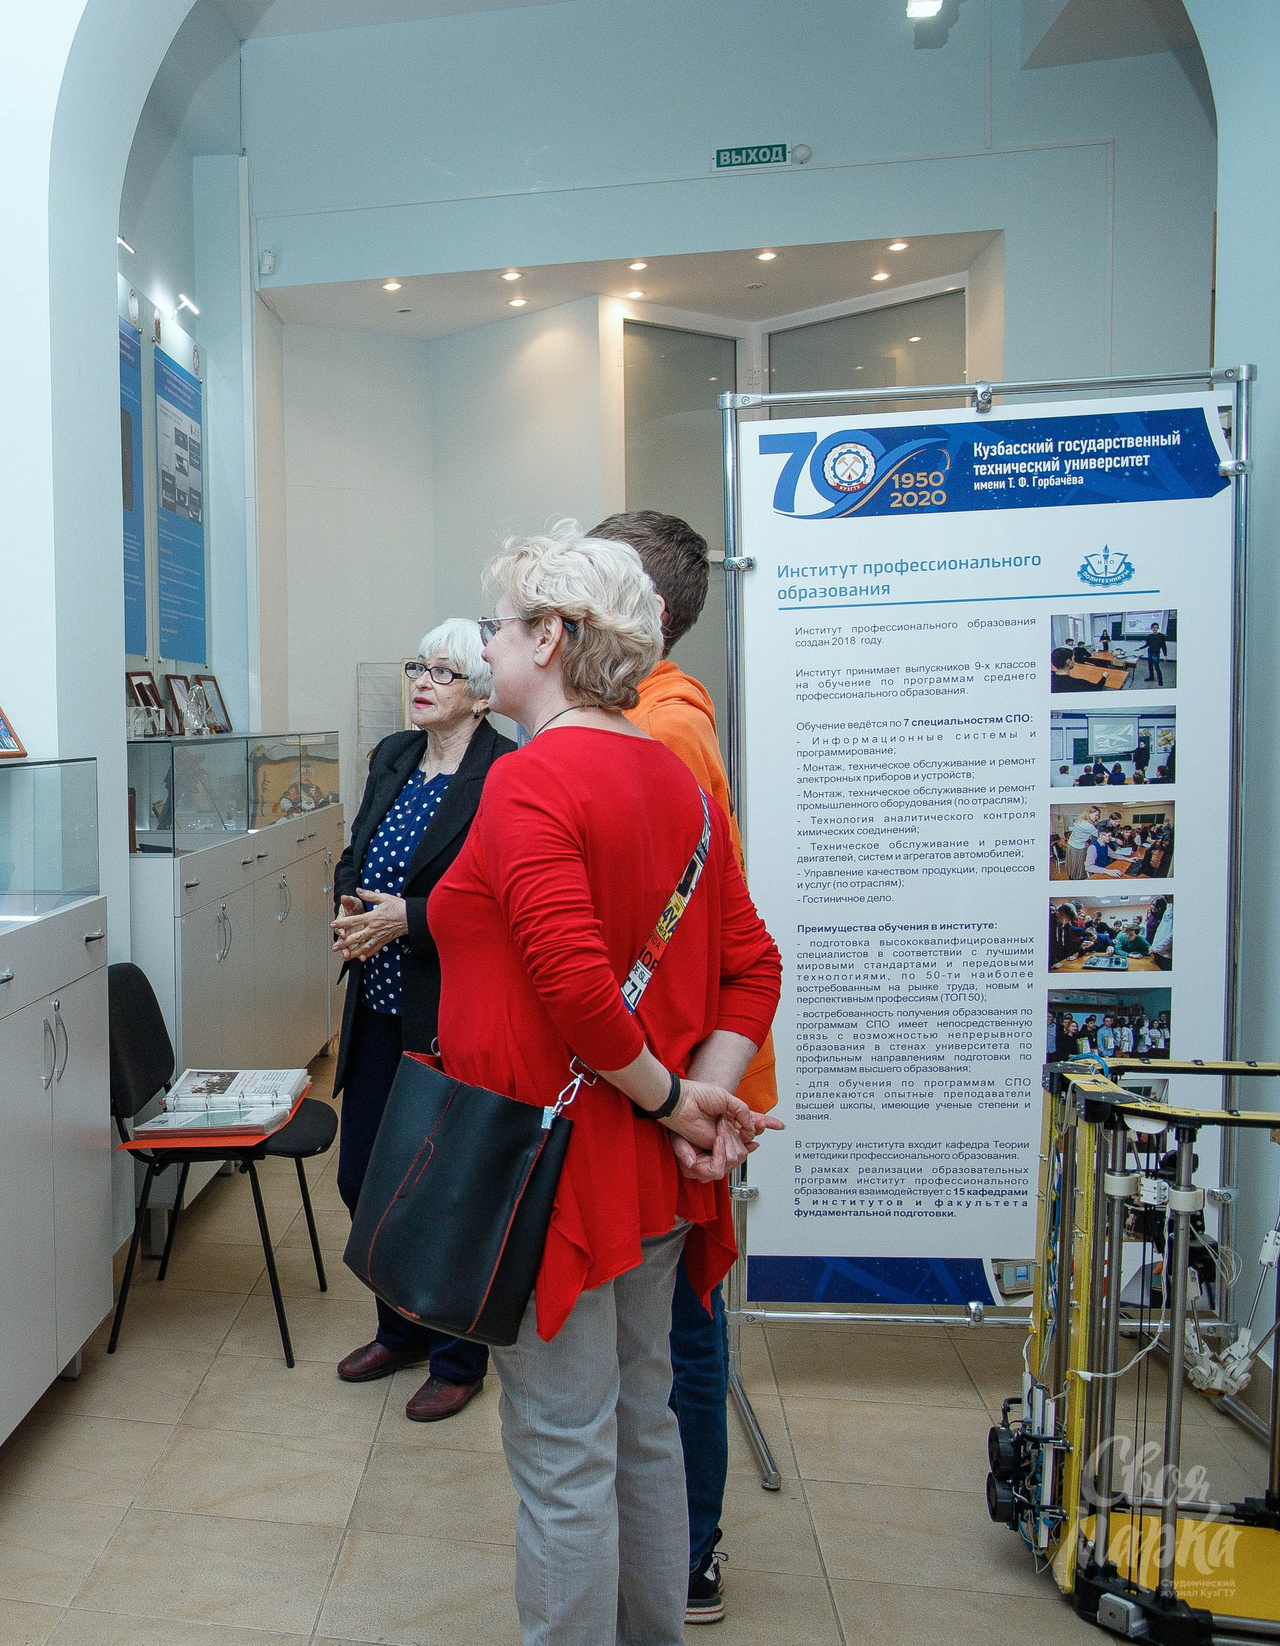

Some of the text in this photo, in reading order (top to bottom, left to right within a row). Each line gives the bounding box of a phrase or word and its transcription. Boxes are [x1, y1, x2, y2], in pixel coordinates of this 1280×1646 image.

[720, 146, 784, 166] ВЫХОД
[973, 430, 1181, 460] Кузбасский государственный
[973, 454, 1150, 476] технический университет
[892, 471, 945, 489] 1950
[973, 474, 1084, 491] имени Т. Ф. Горбачёва
[890, 490, 947, 508] 2020
[777, 553, 1042, 580] Институт профессионального
[777, 581, 891, 602] образования
[794, 617, 1036, 637] Институт профессионального образования
[794, 636, 884, 648] создан 2018 году.
[794, 661, 1036, 678] Институт принимает выпускников 9-х классов
[817, 677, 872, 690] обучение
[902, 676, 974, 687] программам
[983, 674, 1036, 684] среднего
[795, 686, 968, 703] профессионального образования.
[795, 720, 846, 732] Обучение
[846, 718, 888, 730] ведётся
[902, 718, 910, 726] 7
[910, 716, 1004, 728] специальностям
[1004, 713, 1033, 723] СПО:
[796, 775, 862, 785] электронных
[862, 771, 912, 783] приборов
[920, 770, 974, 782] устройств;
[796, 795, 1027, 811] промышленного оборудования (по отраслям);
[796, 922, 876, 935] Преимущества
[877, 922, 930, 933] обучения
[938, 922, 998, 932] институте:
[796, 973, 890, 983] технологиями,
[926, 970, 960, 979] 50-ти
[970, 969, 1034, 979] наиболее
[796, 992, 987, 1006] перспективным профессиям (ТОП 50);
[794, 1139, 1030, 1150] В структуру института входит кафедра Теории
[802, 1153, 848, 1161] методики
[849, 1151, 951, 1161] профессионального
[951, 1151, 1019, 1161] образования.
[793, 1186, 858, 1197] образования
[858, 1187, 944, 1198] взаимодействует
[953, 1187, 966, 1195] 15
[966, 1187, 1028, 1198] кафедрами
[792, 1208, 958, 1219] фундаментальной подготовки.
